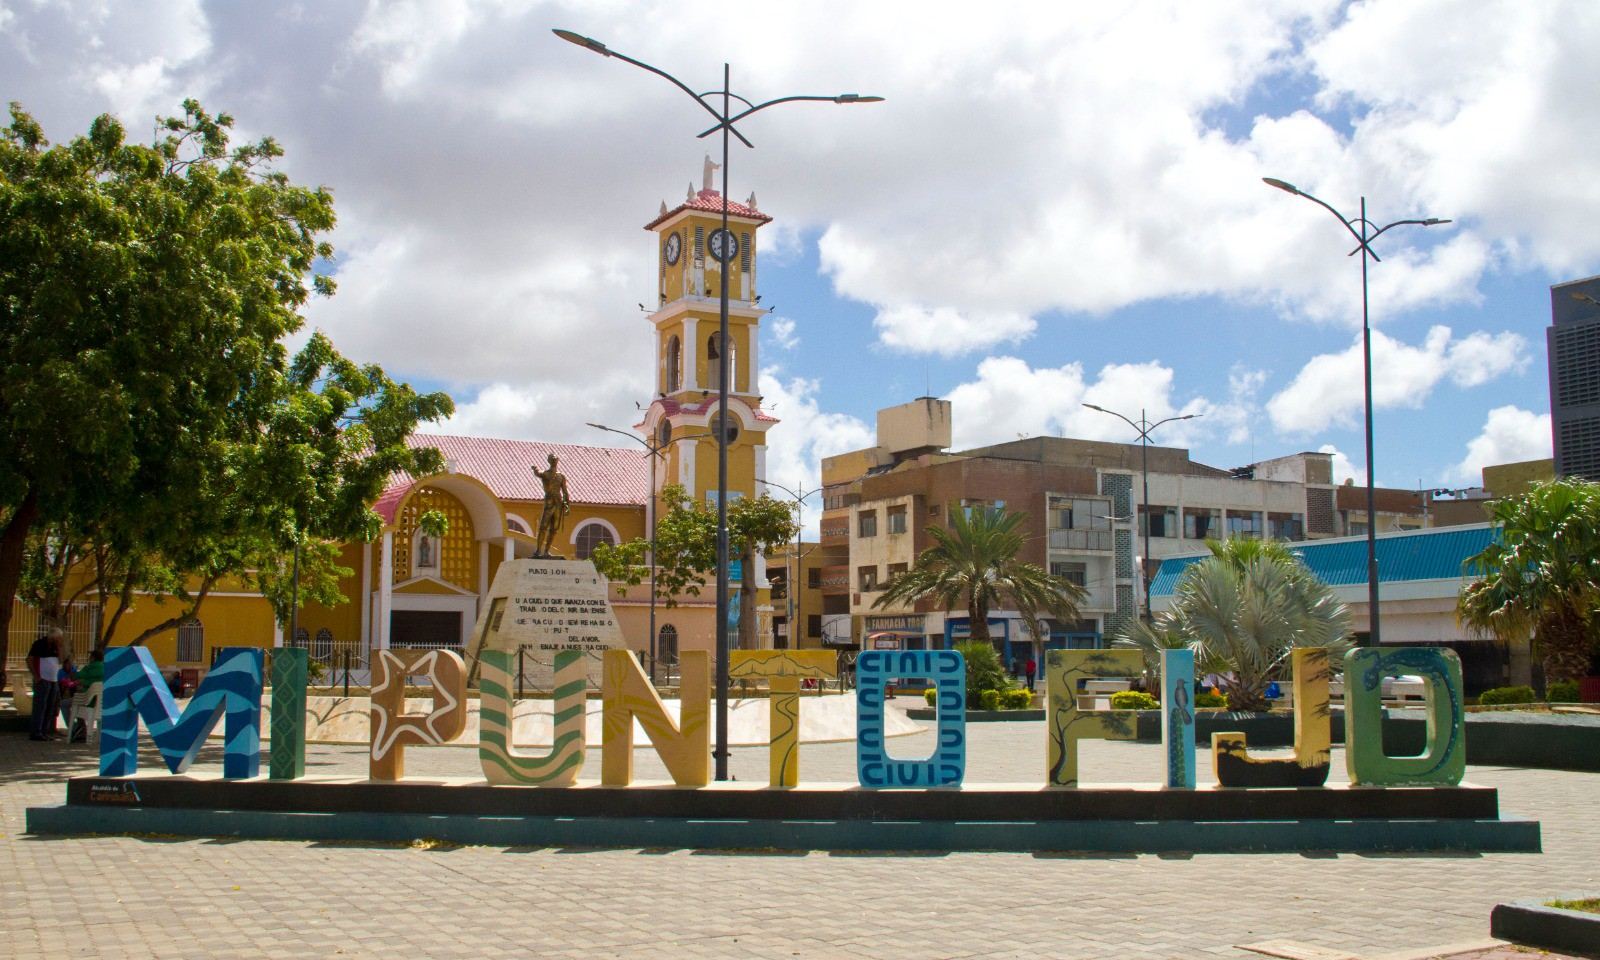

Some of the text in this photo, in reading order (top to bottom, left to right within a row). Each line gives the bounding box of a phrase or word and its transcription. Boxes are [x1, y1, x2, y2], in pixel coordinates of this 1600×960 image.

[871, 618, 906, 630] FARMACIA
[99, 645, 1467, 791] MI PUNTO FIJO
